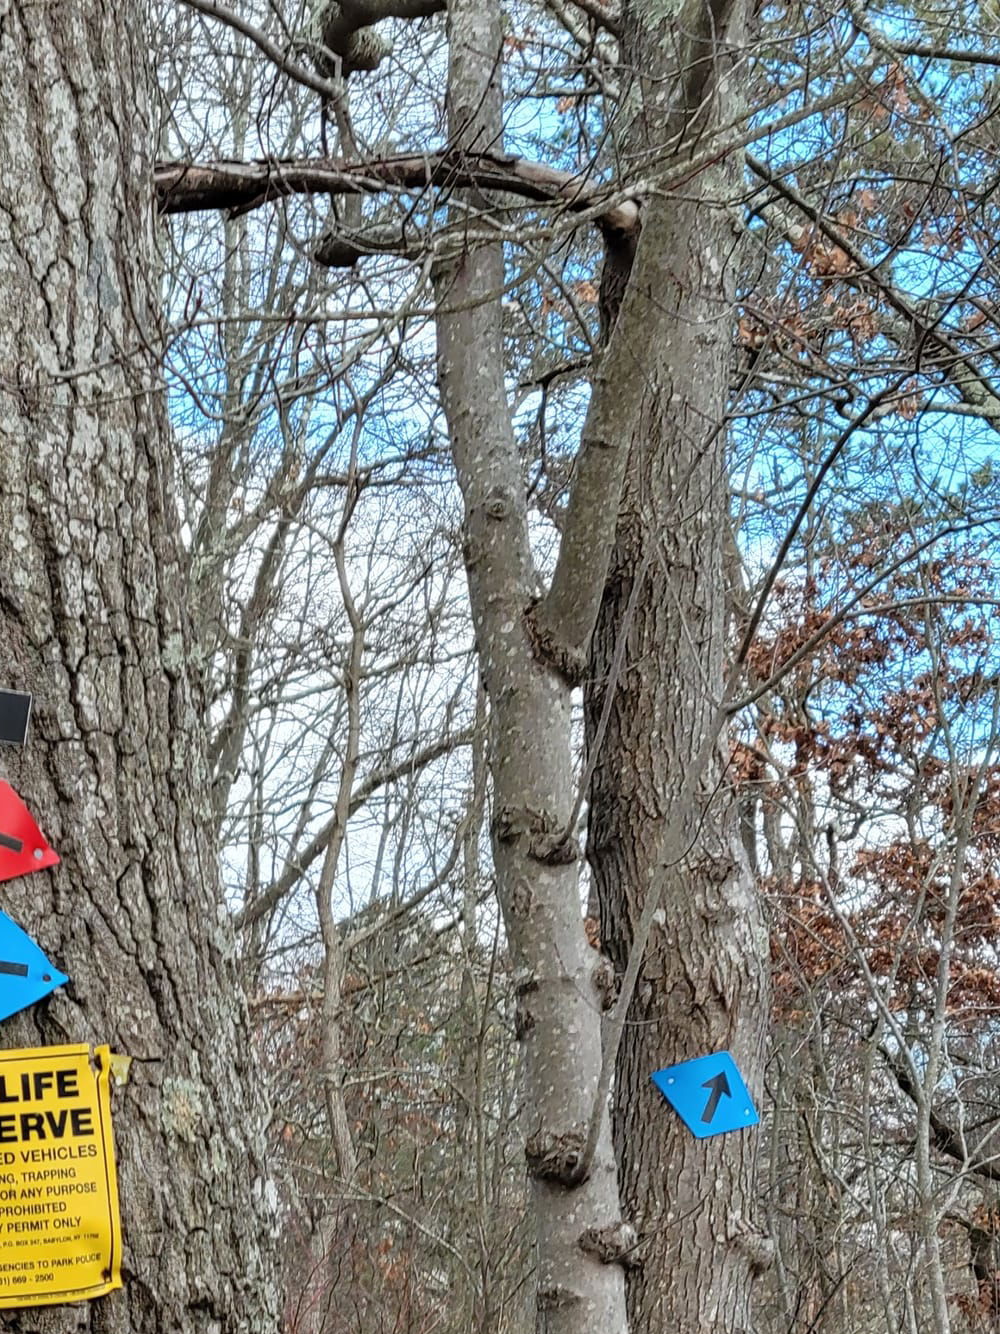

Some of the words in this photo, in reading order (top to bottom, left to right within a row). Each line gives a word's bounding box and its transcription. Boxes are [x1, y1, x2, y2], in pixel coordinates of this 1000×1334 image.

[20, 1144, 97, 1162] VEHICLES
[21, 1167, 76, 1182] TRAPPING
[20, 1187, 42, 1200] ANY
[46, 1182, 97, 1197] PURPOSE
[7, 1220, 49, 1232] PERMIT
[53, 1216, 81, 1228] ONLY
[38, 1260, 49, 1268] TO
[51, 1257, 74, 1267] PARK
[76, 1253, 102, 1264] POLICE
[34, 1273, 54, 1282] 2500
